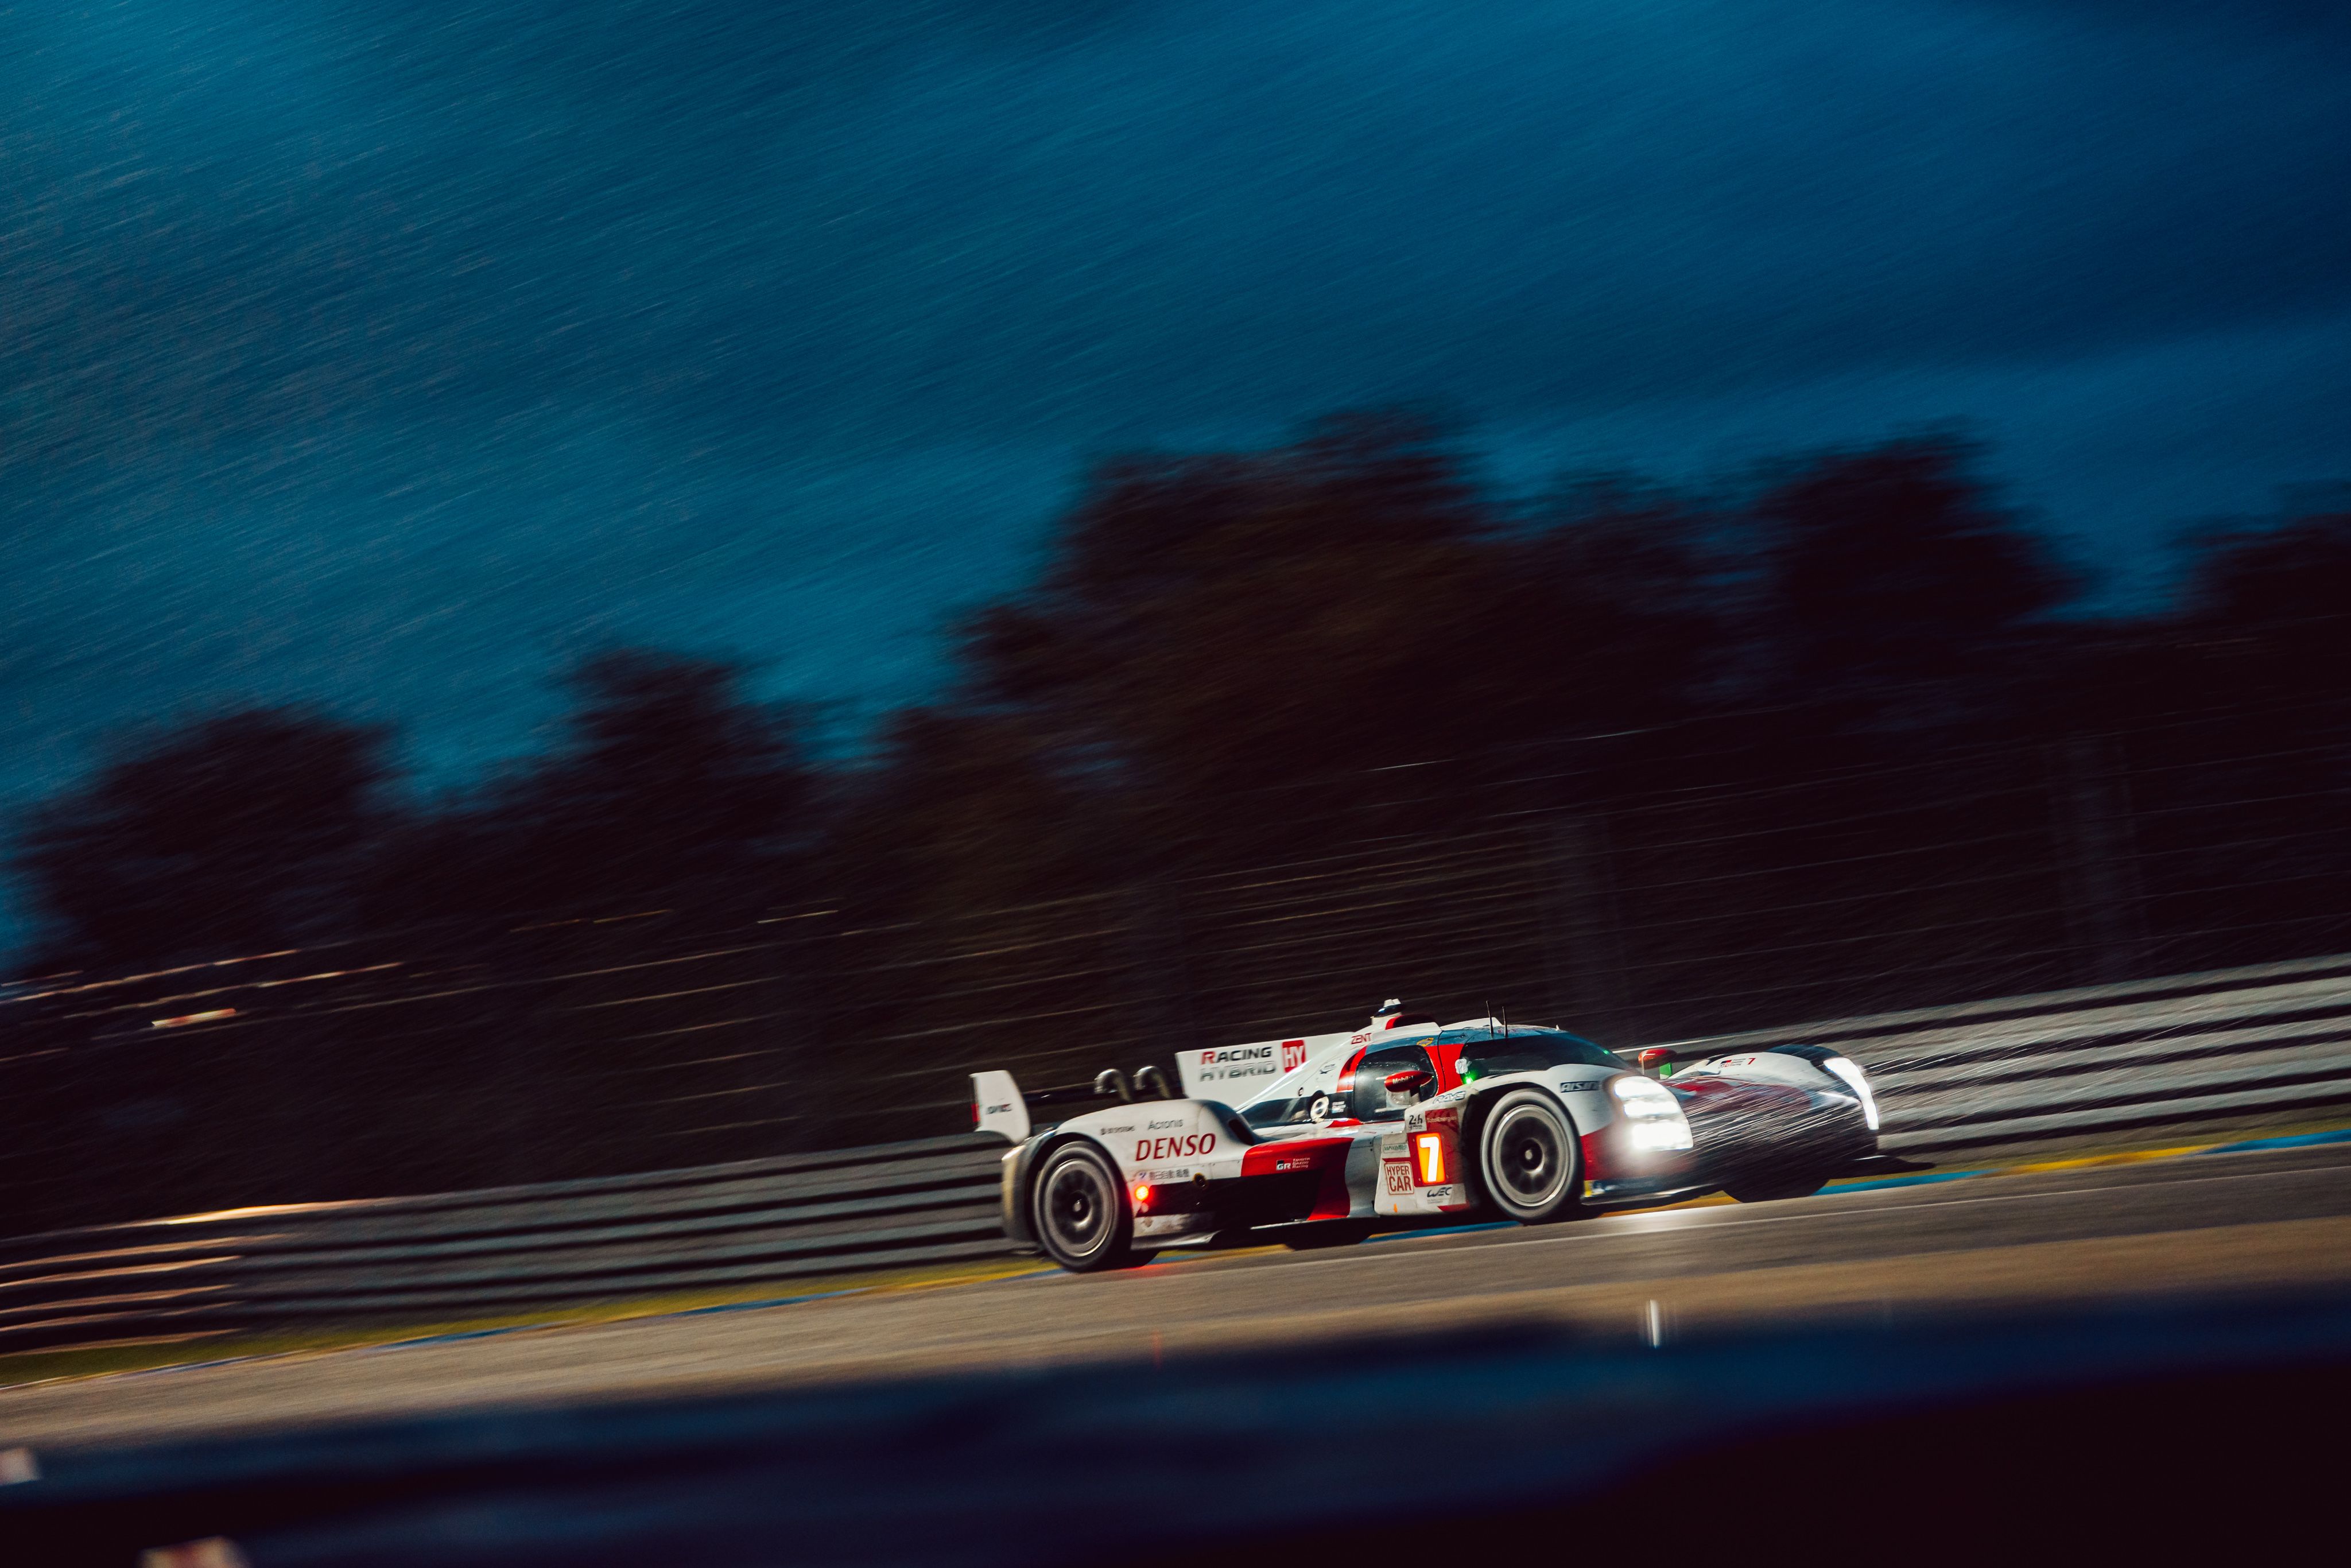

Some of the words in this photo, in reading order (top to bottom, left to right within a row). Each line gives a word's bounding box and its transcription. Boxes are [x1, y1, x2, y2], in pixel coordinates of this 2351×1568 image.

[1351, 1033, 1372, 1045] ZENT
[1201, 1046, 1272, 1065] RACING
[1283, 1046, 1305, 1068] HY
[1200, 1060, 1277, 1082] HYBRID
[1433, 1091, 1466, 1104] RAYS
[1147, 1119, 1183, 1130] Acronis
[1135, 1133, 1216, 1161] DENSO
[1419, 1136, 1439, 1182] 7
[1277, 1163, 1291, 1171] GR
[1386, 1165, 1410, 1176] HYPER
[1389, 1176, 1411, 1192] CAR
[1427, 1187, 1452, 1197] WEC
